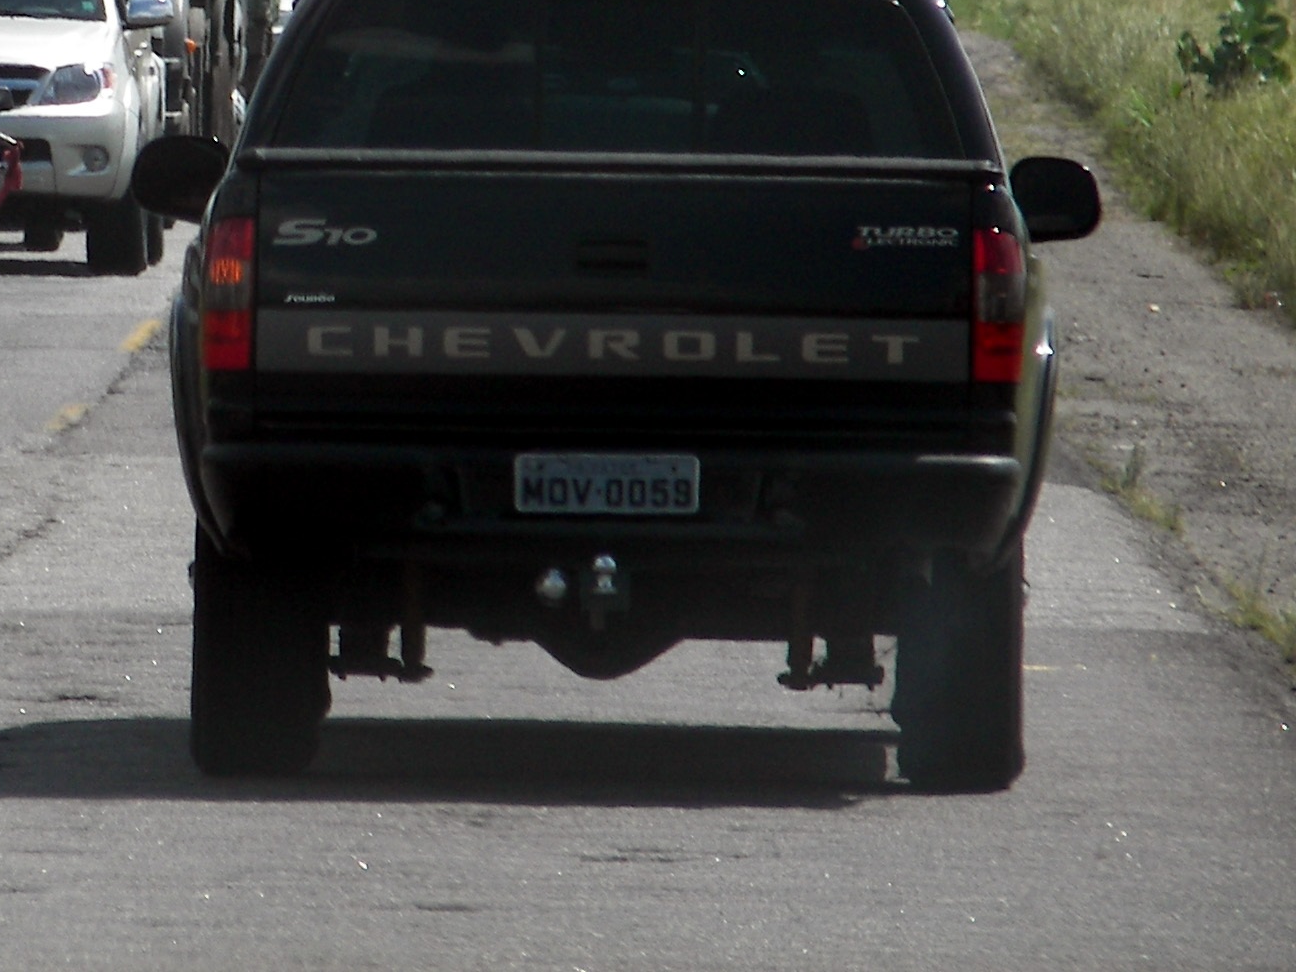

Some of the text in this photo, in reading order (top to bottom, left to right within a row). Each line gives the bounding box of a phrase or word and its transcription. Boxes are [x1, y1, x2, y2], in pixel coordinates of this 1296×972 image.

[272, 218, 378, 246] S10
[857, 226, 959, 238] TURBO
[306, 324, 920, 365] CHEVROLET
